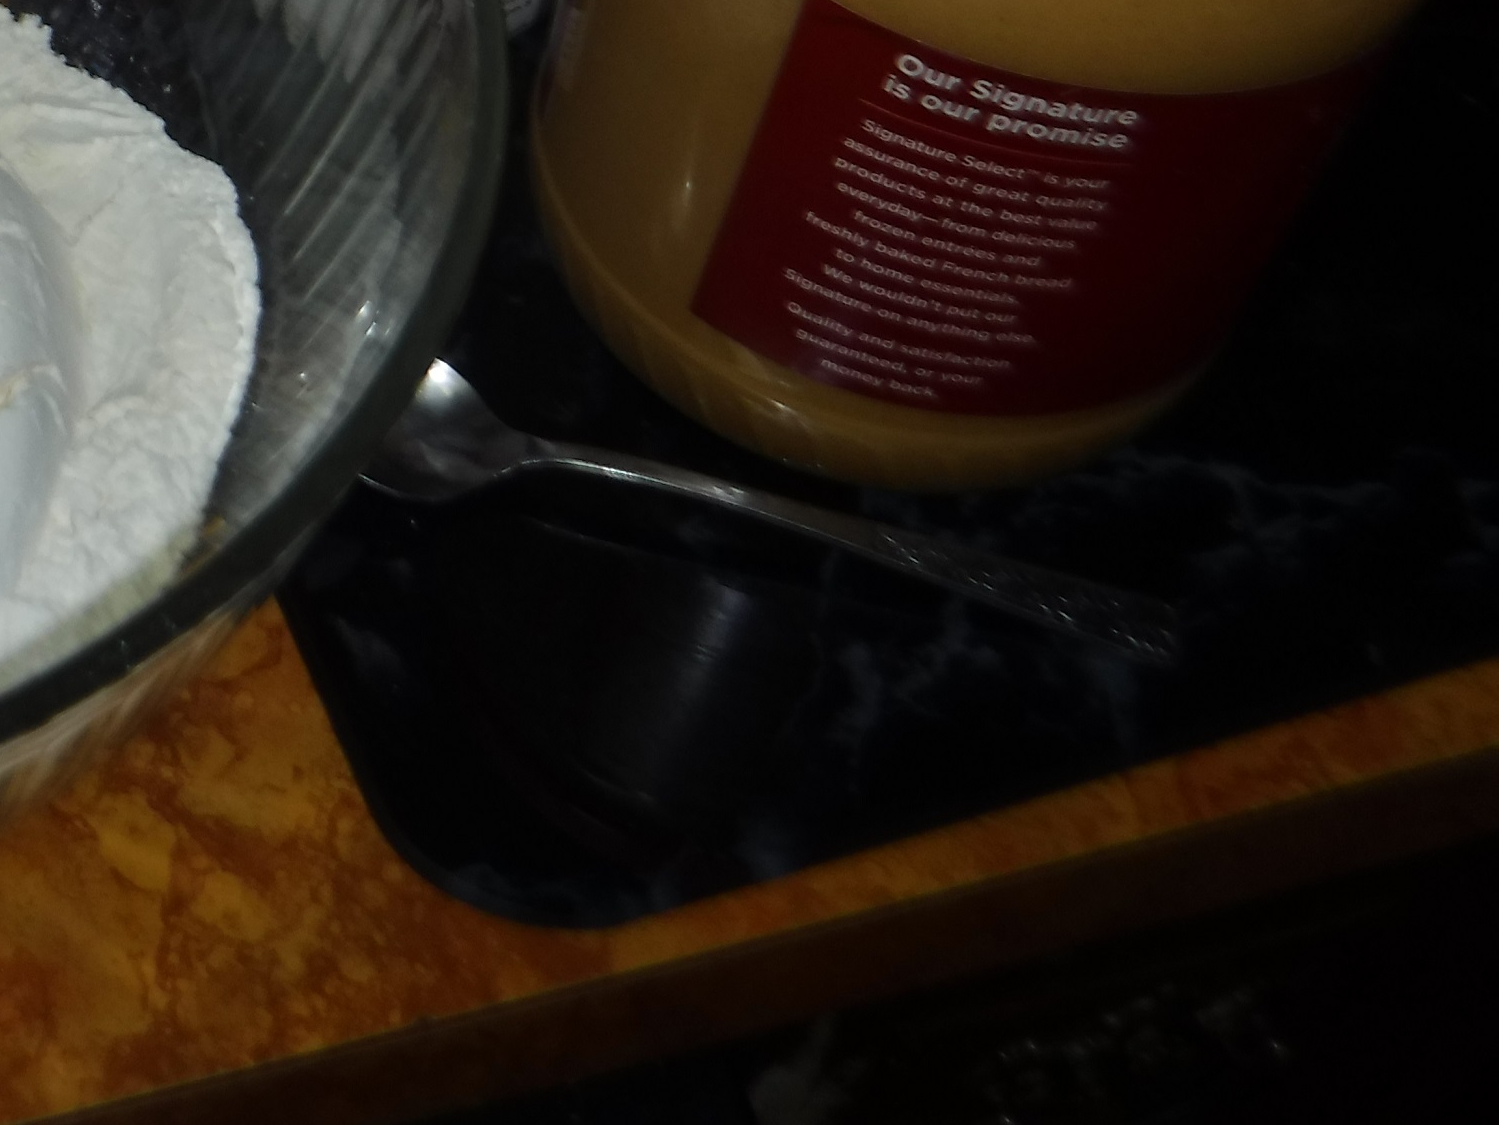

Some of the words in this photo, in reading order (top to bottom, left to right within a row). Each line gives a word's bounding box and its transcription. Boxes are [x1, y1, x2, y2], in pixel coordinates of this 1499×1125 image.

[883, 73, 913, 102] is
[920, 93, 980, 123] our
[985, 112, 1130, 148] promise
[896, 53, 963, 94] Our
[969, 78, 1140, 126] Signature
[843, 137, 941, 183] assurance
[945, 175, 969, 190] of
[971, 182, 1031, 205] great
[1035, 194, 1110, 213] quality
[860, 117, 958, 164] Signature
[1043, 171, 1061, 186] is
[1063, 176, 1112, 191] your
[834, 156, 927, 201] products
[931, 193, 954, 208] at
[959, 199, 994, 218] the
[999, 207, 1043, 227] best
[1046, 216, 1099, 231] value
[804, 209, 870, 249] freshly
[874, 240, 937, 269] baked
[941, 260, 1010, 283] French
[1014, 273, 1074, 290] bread
[835, 247, 856, 264] to
[860, 257, 915, 285] home
[853, 209, 917, 241] frozen
[1001, 253, 1044, 269] and
[991, 228, 1078, 250] delicious
[783, 266, 873, 313] Signature
[876, 307, 902, 323] on
[905, 315, 991, 343] anything
[822, 262, 854, 285] We
[858, 279, 942, 313] wouldn't
[945, 305, 981, 320] put
[984, 311, 1016, 323] our
[786, 299, 854, 338] Quality
[858, 331, 896, 351] and
[899, 343, 1014, 369] satisfaction
[819, 358, 884, 388] money
[914, 366, 935, 378] or
[940, 371, 985, 386] your
